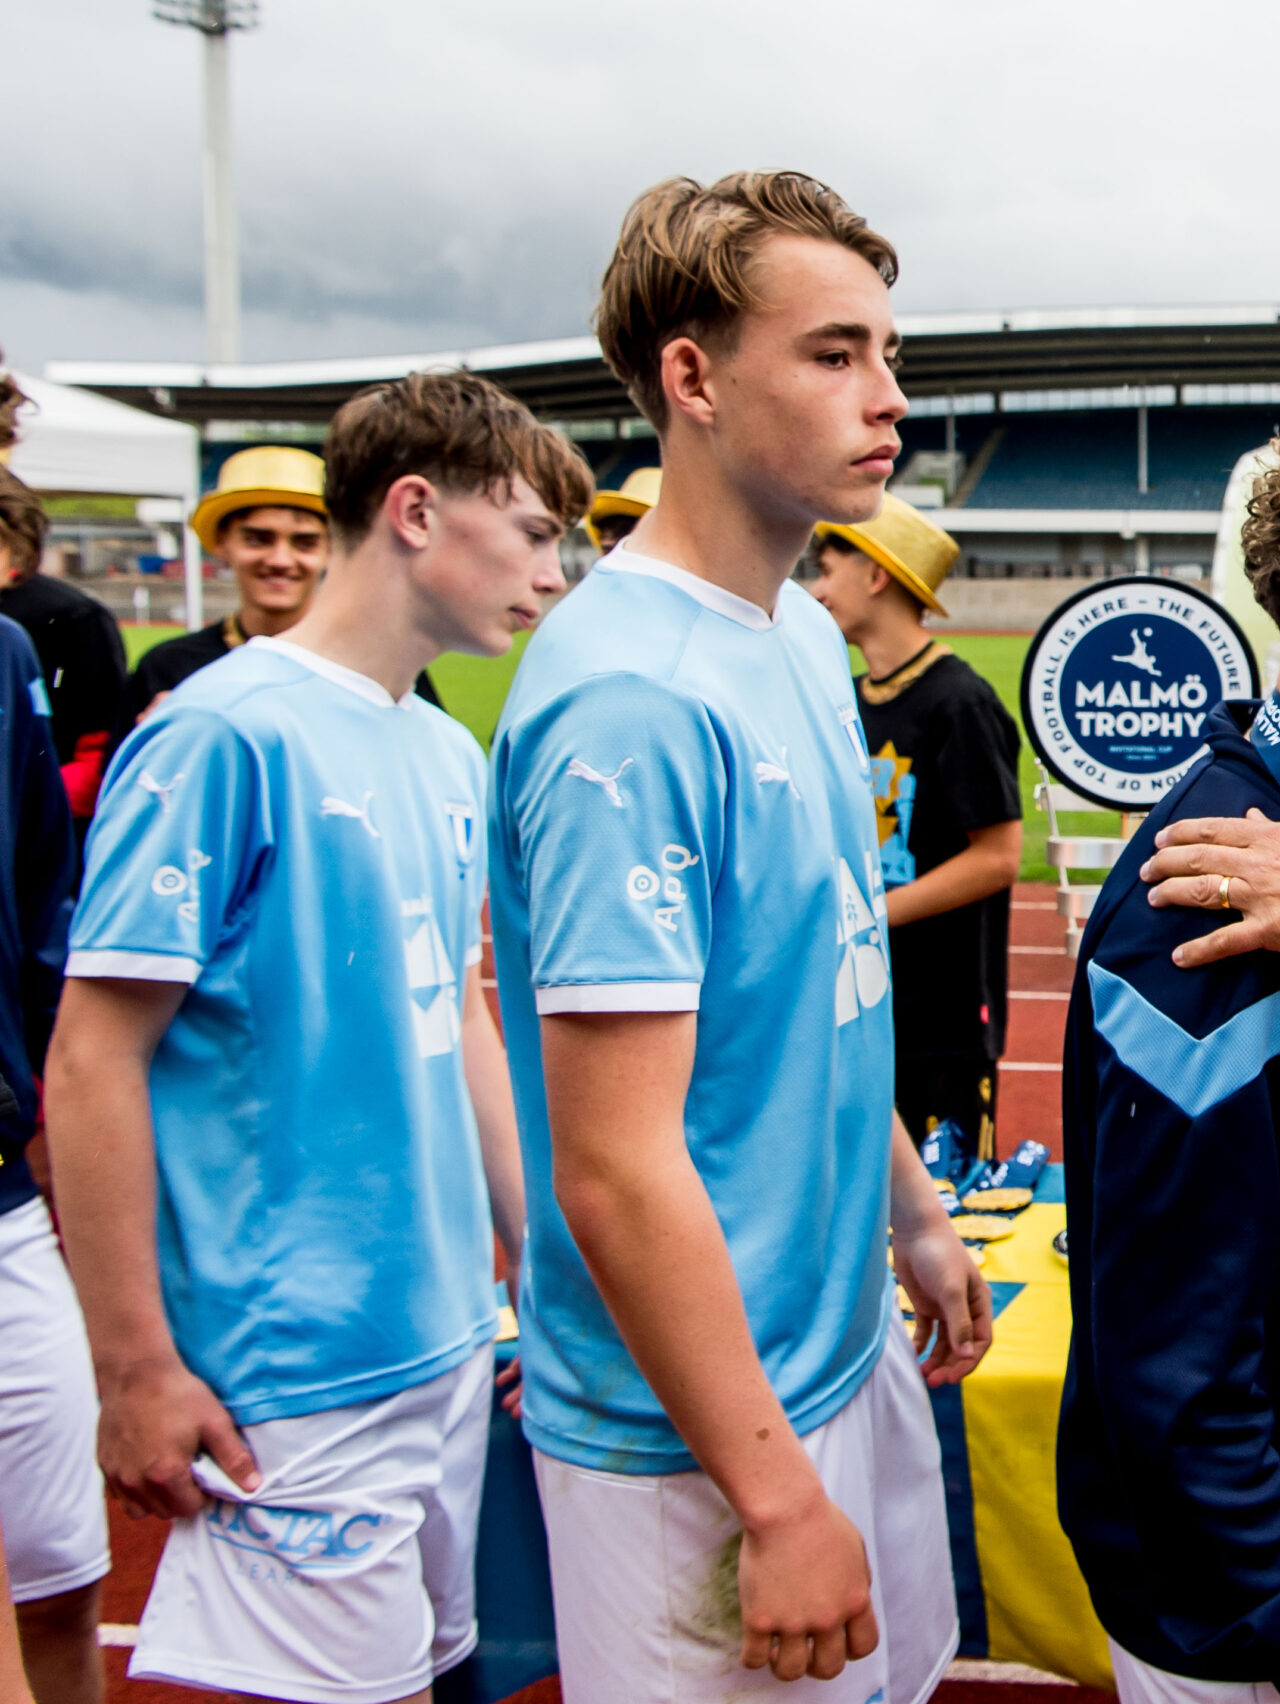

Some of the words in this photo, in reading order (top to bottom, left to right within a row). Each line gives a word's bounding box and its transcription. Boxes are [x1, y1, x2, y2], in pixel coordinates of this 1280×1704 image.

[1078, 597, 1128, 628] HERE
[1157, 597, 1195, 621] THE
[1059, 629, 1076, 646] IS
[1199, 620, 1242, 692] FUTURE
[1041, 654, 1072, 754] FOOTBALL
[1075, 674, 1208, 709] MALMÖ
[1075, 711, 1207, 738] TROPHY
[1073, 757, 1107, 783] TOP
[1116, 779, 1141, 791] OF
[654, 843, 700, 933] APQ
